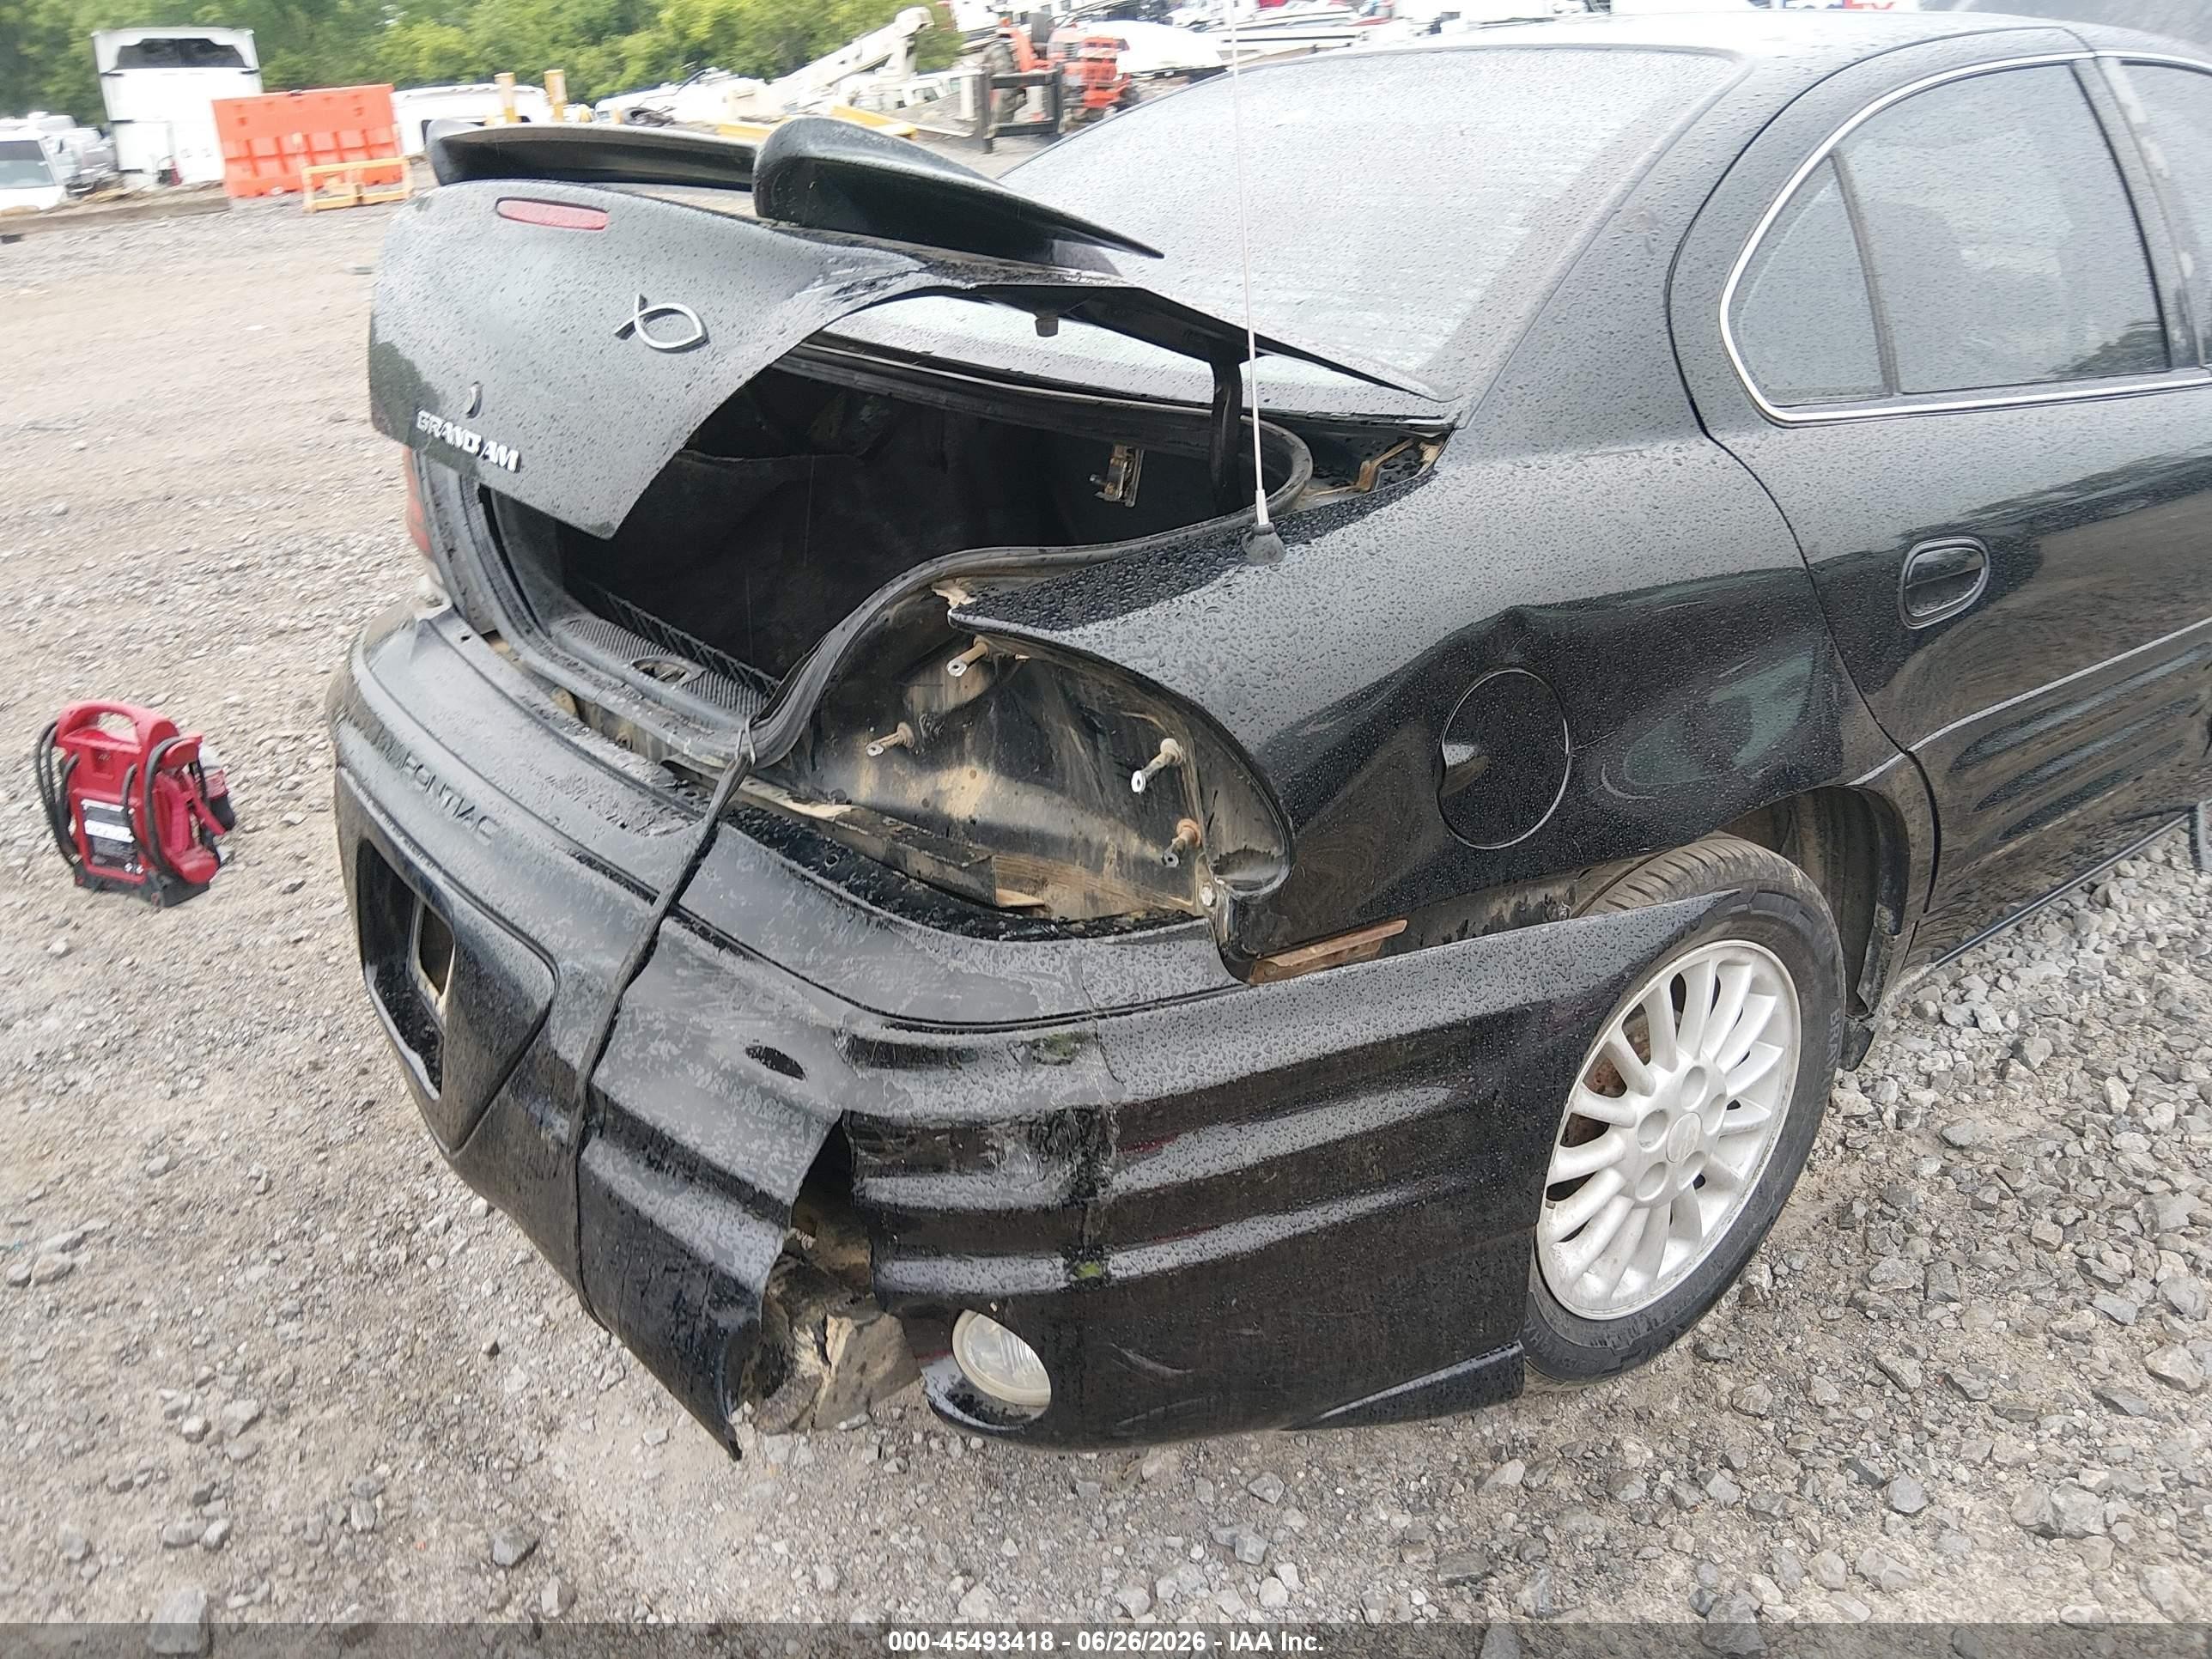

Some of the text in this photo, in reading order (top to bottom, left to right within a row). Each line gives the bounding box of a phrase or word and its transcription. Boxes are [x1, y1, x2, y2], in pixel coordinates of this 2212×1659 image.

[416, 410, 520, 472] GRAND AM
[400, 750, 501, 846] PONTIAC
